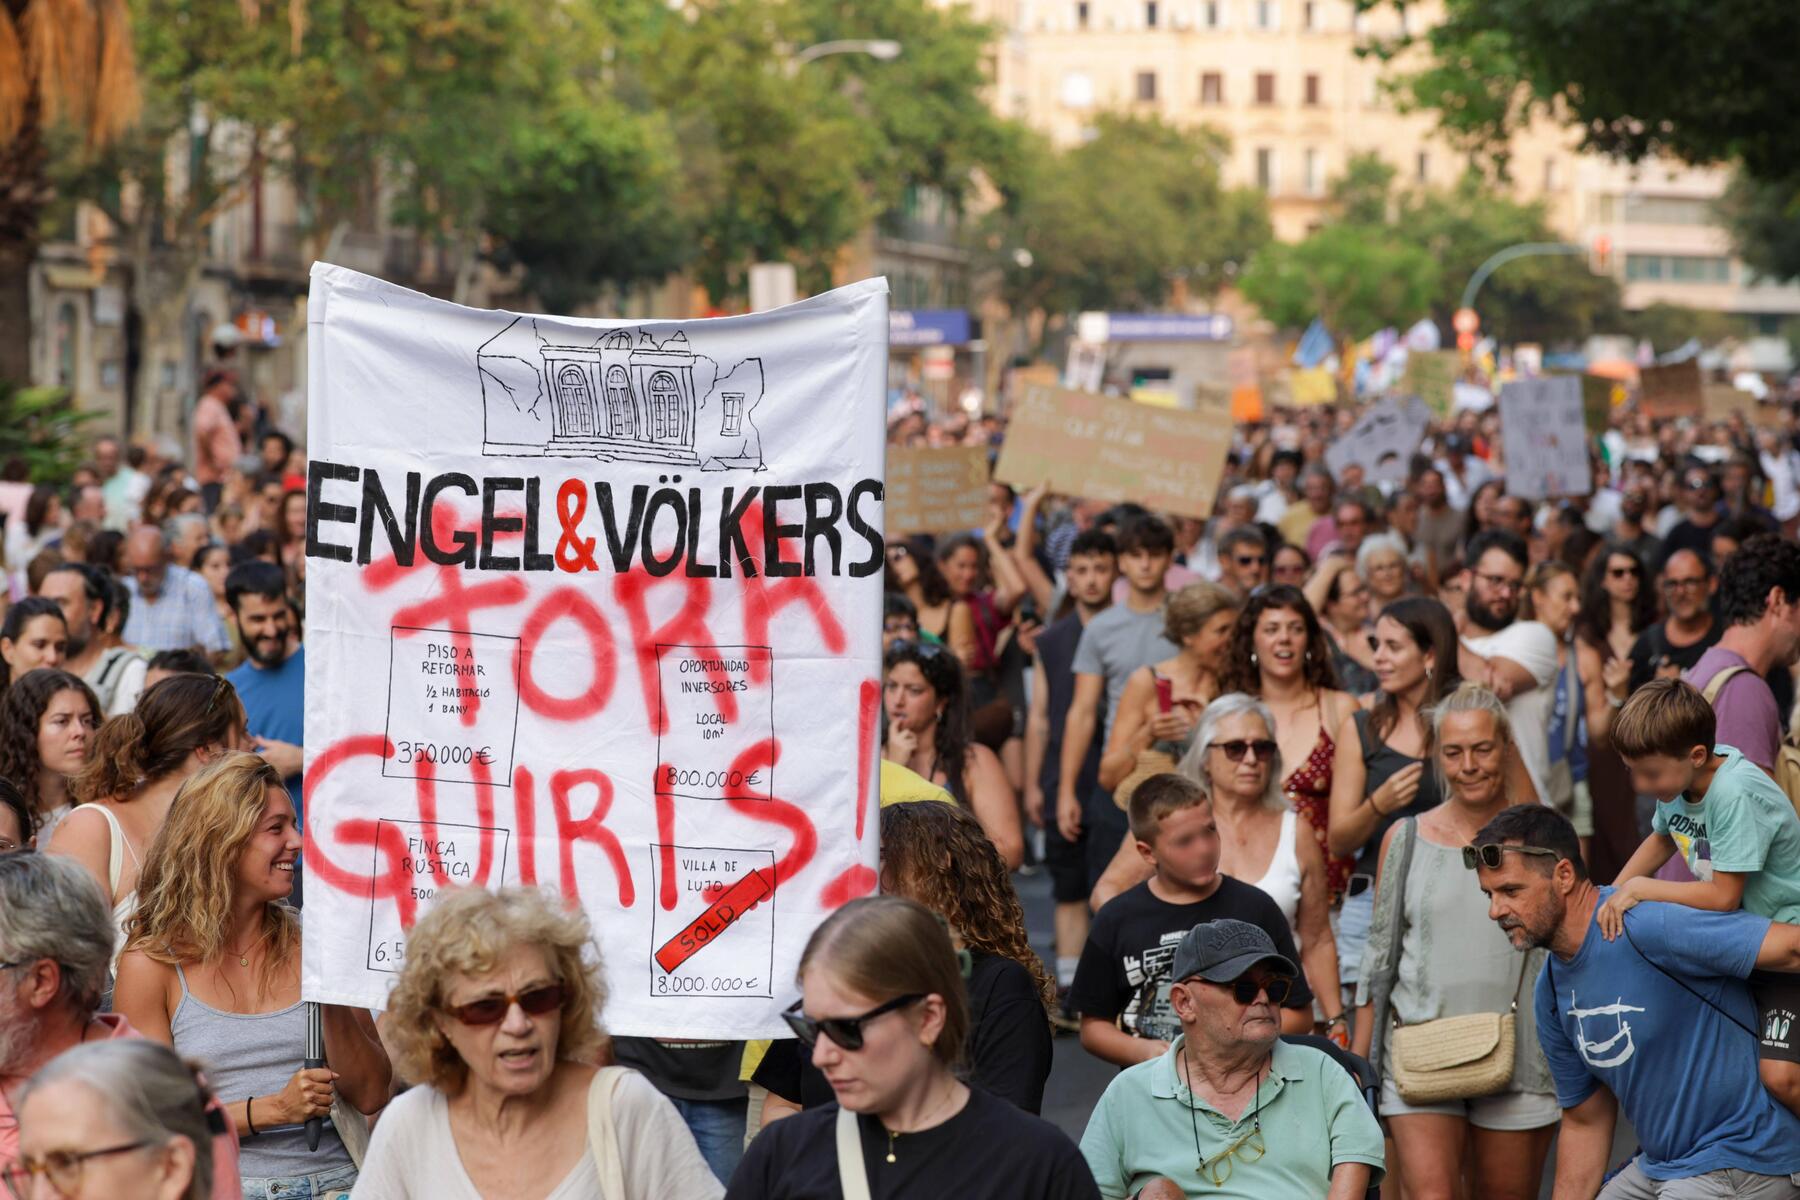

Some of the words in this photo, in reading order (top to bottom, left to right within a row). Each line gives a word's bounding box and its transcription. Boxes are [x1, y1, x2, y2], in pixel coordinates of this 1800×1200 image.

[427, 643, 458, 659] PISO
[464, 648, 473, 659] A
[421, 661, 486, 676] REFORMAR
[679, 659, 750, 673] OPORTUNIDAD
[681, 680, 748, 694] INVERSORES
[428, 703, 434, 713] 1
[442, 704, 468, 716] BANY
[696, 713, 728, 725] LOCAL
[397, 741, 497, 766] 350.000€
[666, 766, 762, 788] 800.000€
[408, 837, 456, 857] FINCA
[682, 859, 717, 872] VILLA
[724, 860, 738, 872] DE
[687, 879, 723, 892] LUJO
[410, 887, 435, 901] 500
[680, 904, 735, 953] SOLD
[374, 941, 404, 962] 6.5
[658, 975, 759, 994] 8.000.000€
